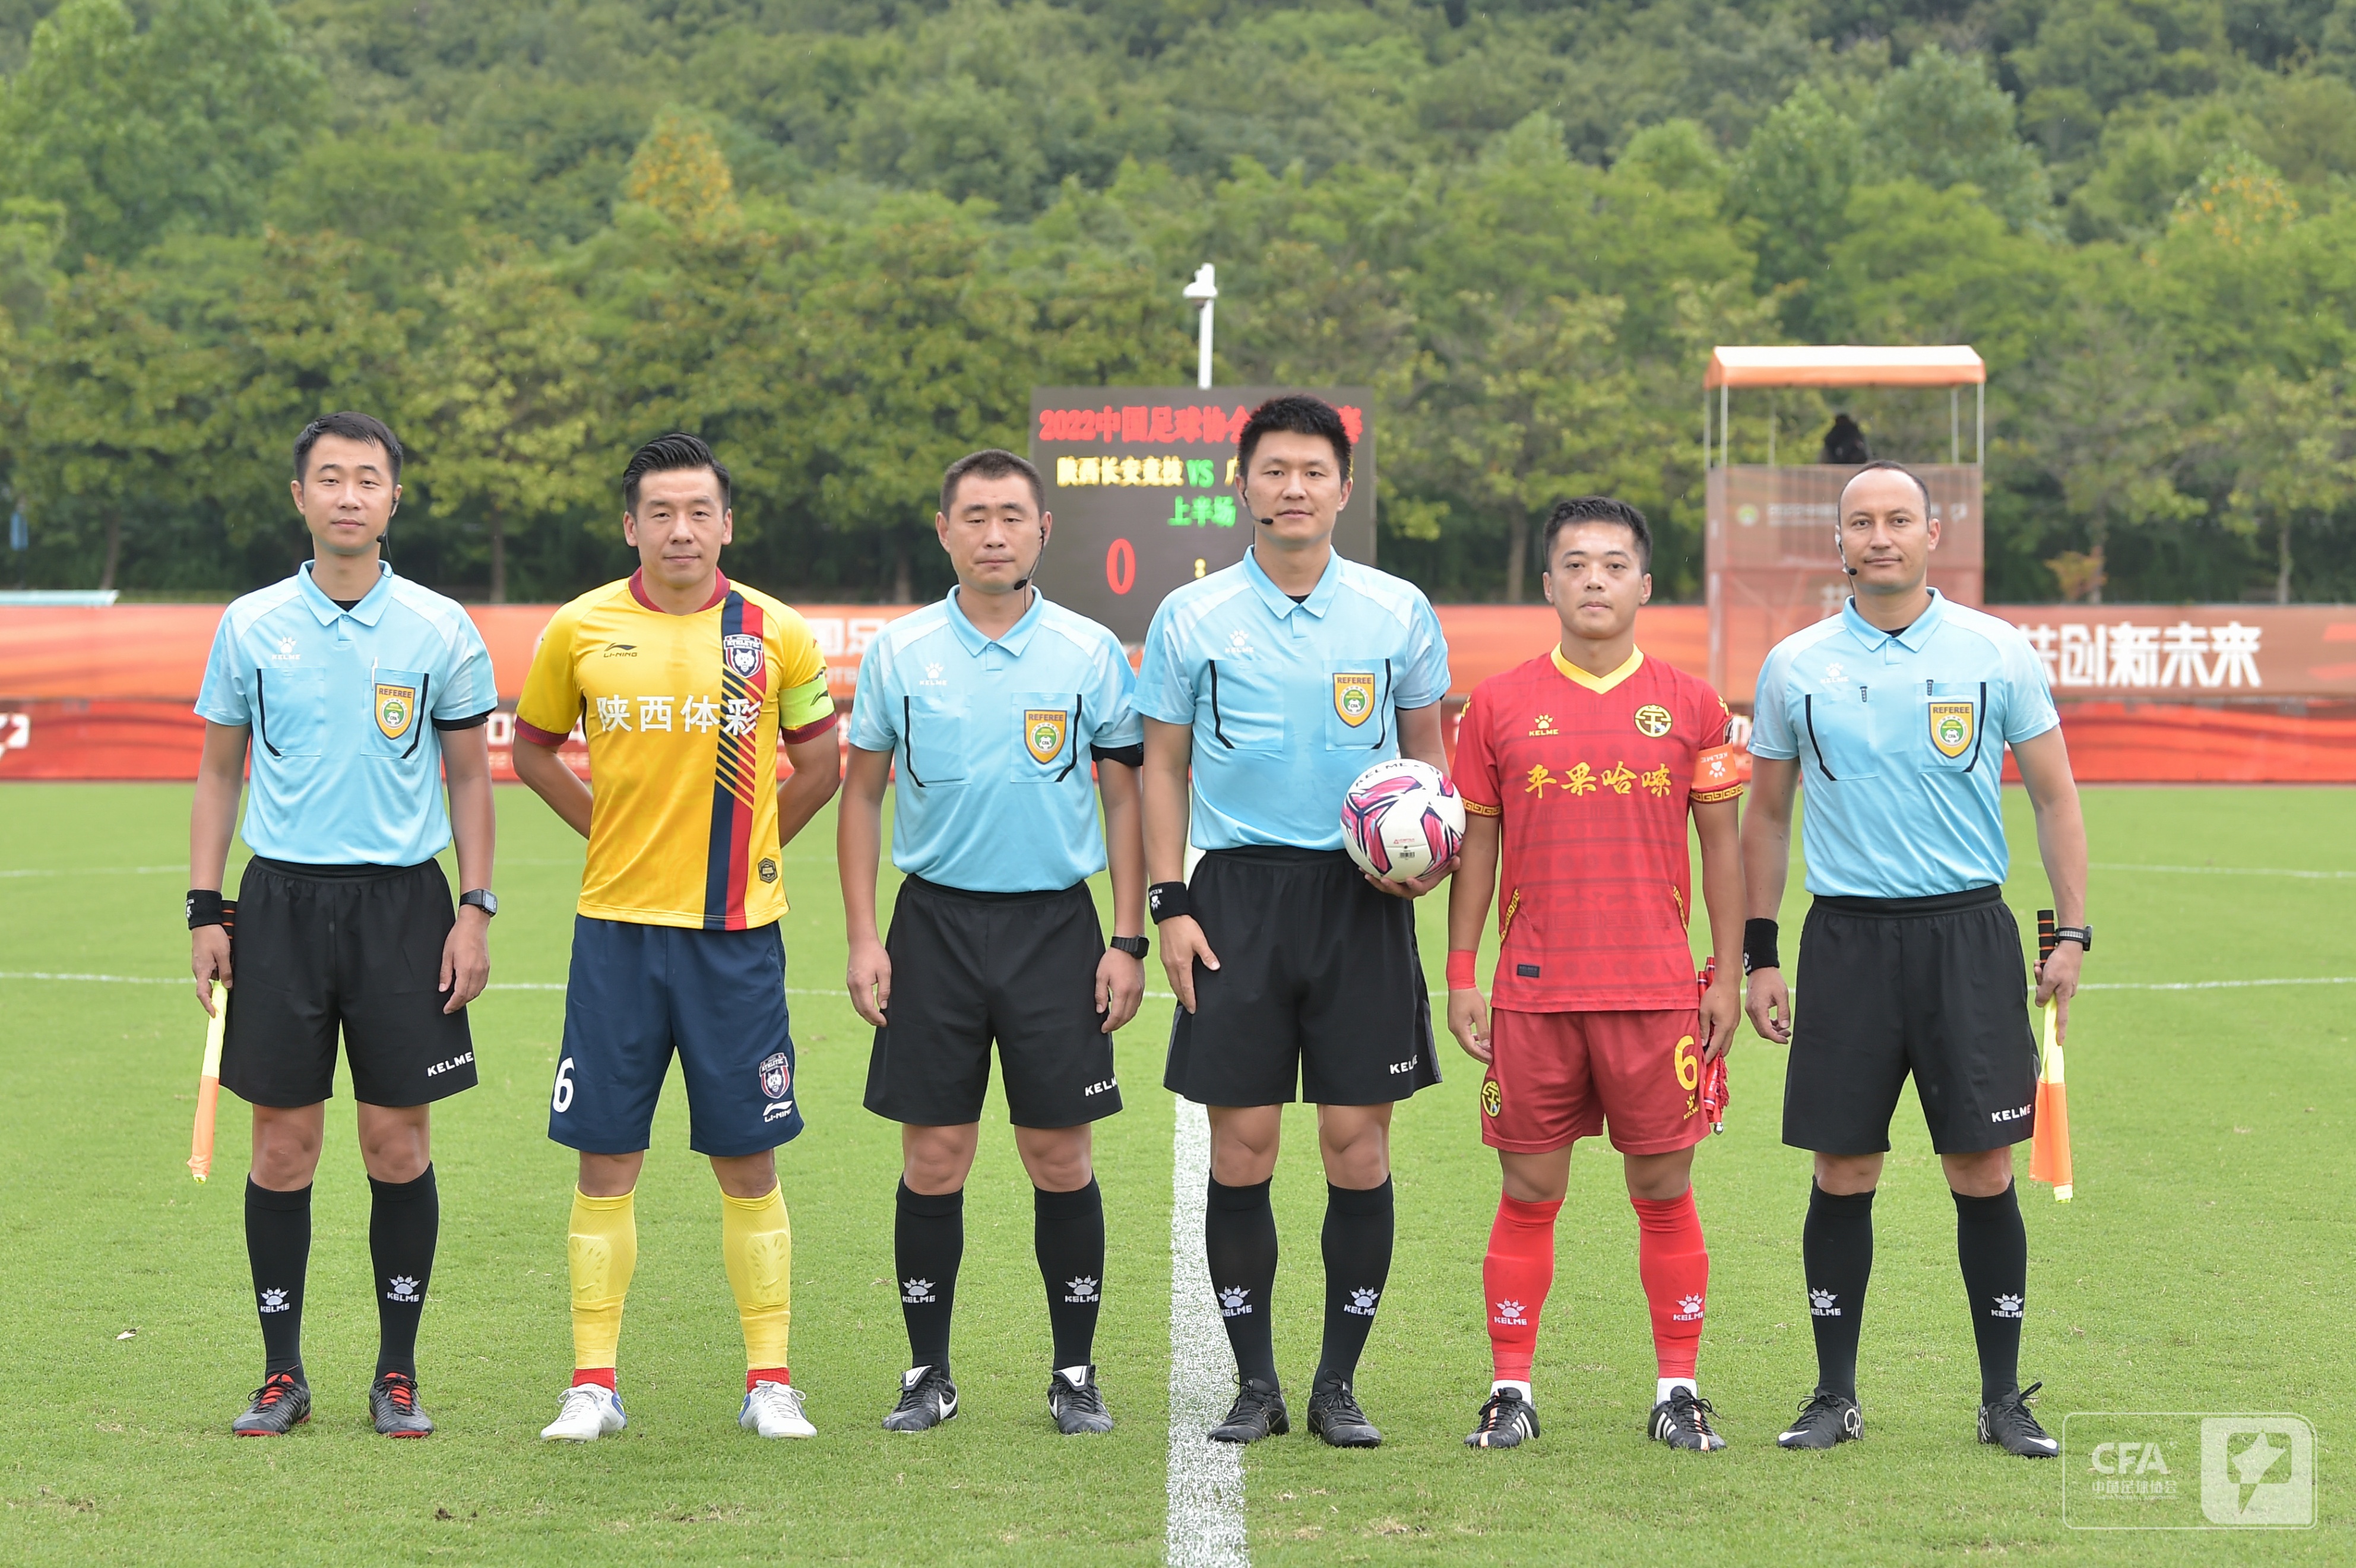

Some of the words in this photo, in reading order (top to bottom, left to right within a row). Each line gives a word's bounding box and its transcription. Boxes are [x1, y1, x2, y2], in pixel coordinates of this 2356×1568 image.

[1186, 459, 1215, 488] VS
[1167, 495, 1236, 528] 上半场
[1106, 538, 1135, 594] 0
[2019, 620, 2263, 688] 共创新未来
[379, 688, 413, 699] REFEREE
[596, 693, 762, 736] 陕西体彩
[1700, 752, 1728, 763] KELME
[427, 1051, 474, 1077] KELME
[1674, 1035, 1698, 1091] 6
[552, 1057, 575, 1113] 6
[1991, 1103, 2031, 1123] KELME
[260, 1302, 290, 1314] KELME
[387, 1291, 420, 1303] KELME
[902, 1295, 936, 1304] KELME
[1065, 1293, 1099, 1303] KELME
[1494, 1316, 1528, 1326] KELME
